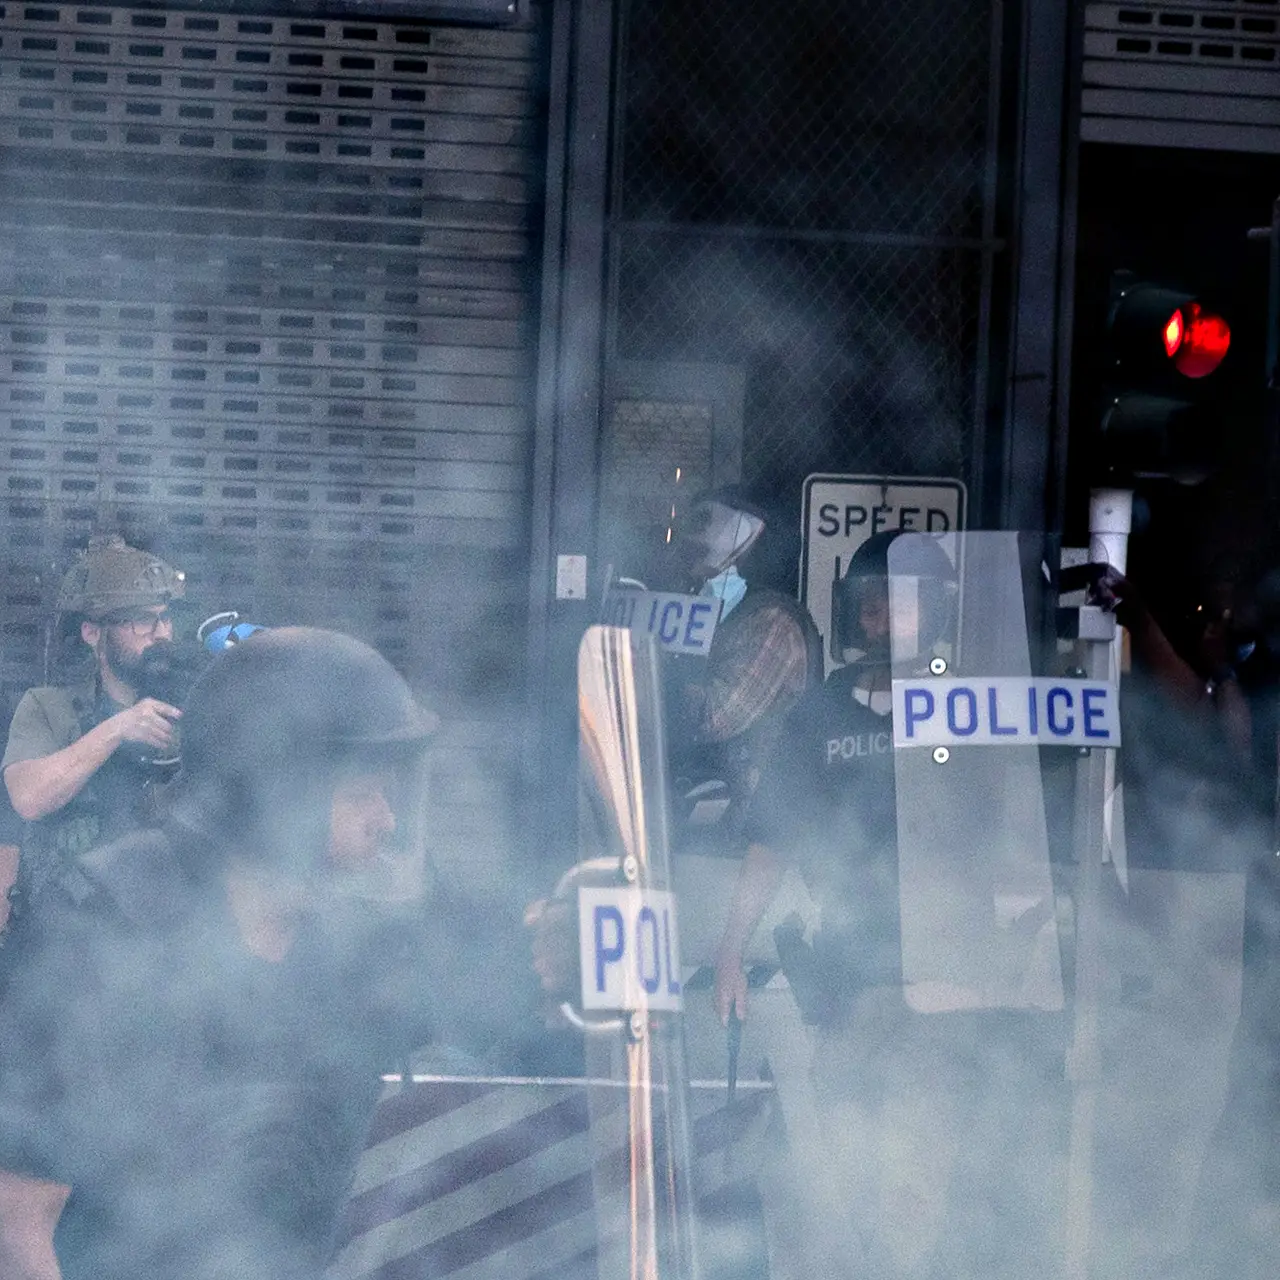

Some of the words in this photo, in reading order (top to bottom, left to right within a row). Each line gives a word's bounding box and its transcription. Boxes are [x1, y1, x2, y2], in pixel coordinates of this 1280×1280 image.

[817, 503, 951, 537] SPEED
[903, 686, 1111, 739] POLICE
[826, 732, 893, 764] POLIC
